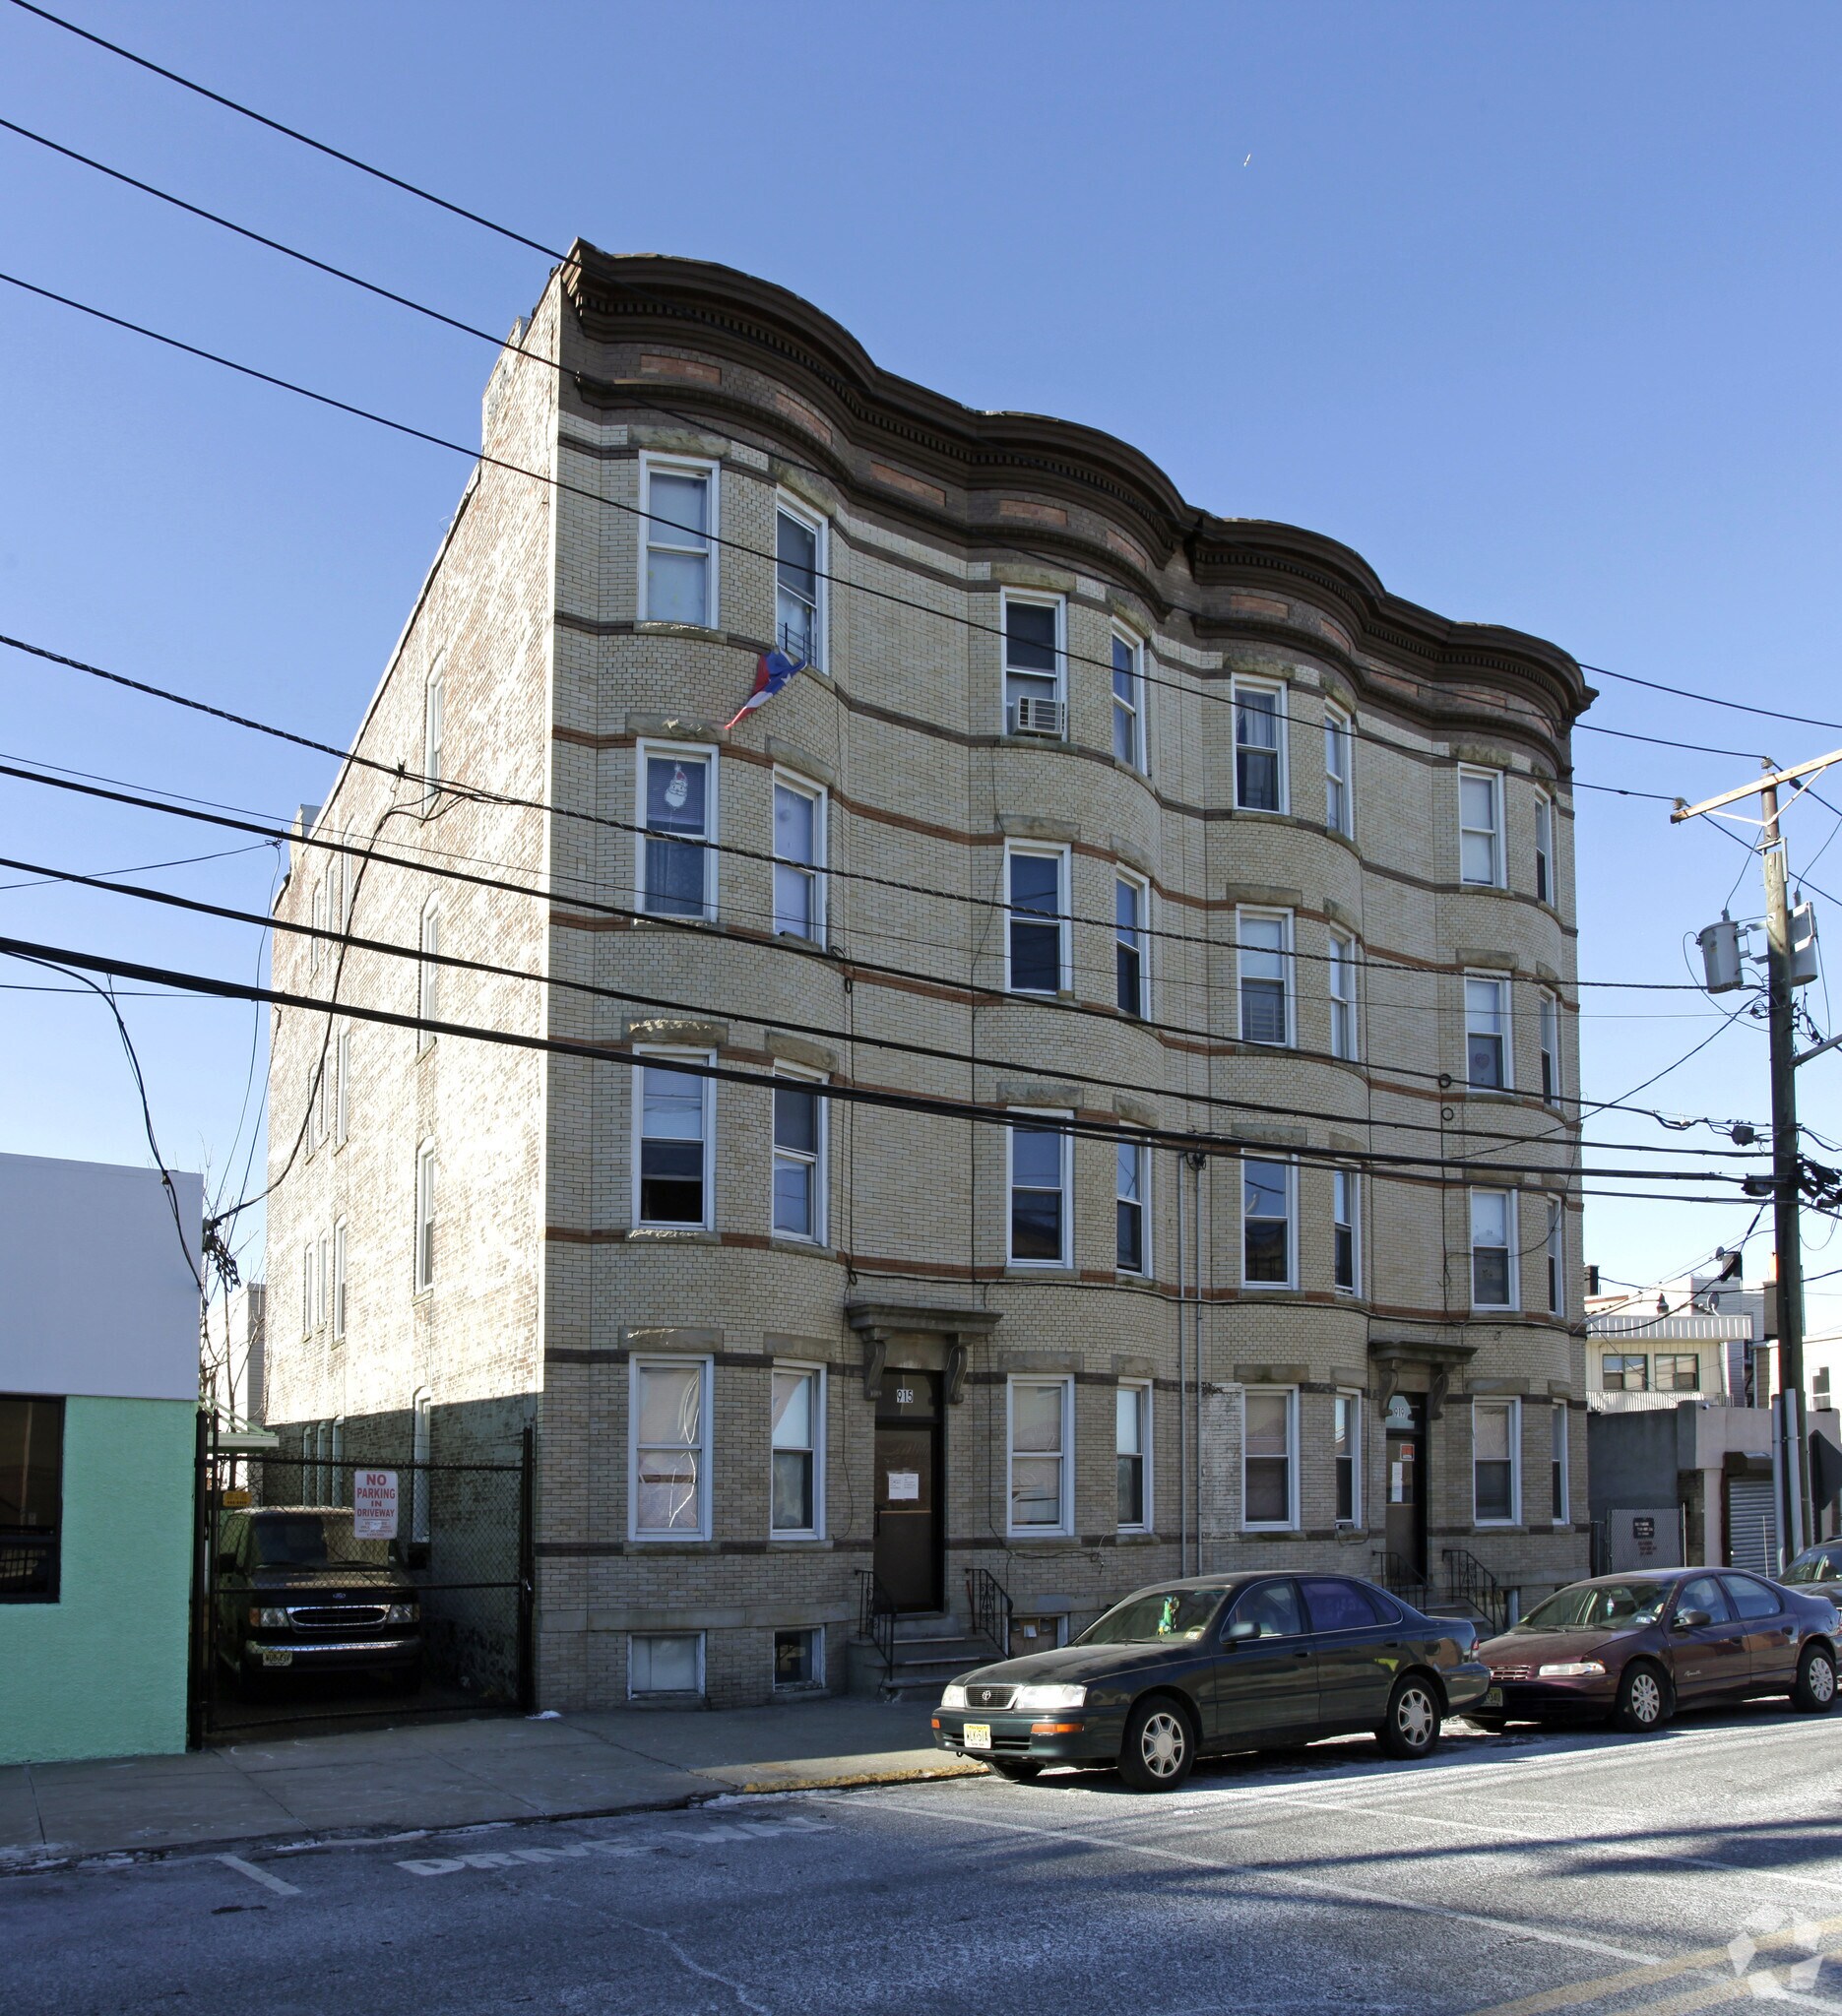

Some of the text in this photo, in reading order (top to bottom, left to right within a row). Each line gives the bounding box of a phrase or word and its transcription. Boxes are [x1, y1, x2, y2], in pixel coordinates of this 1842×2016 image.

[897, 1390, 913, 1403] 915
[1394, 1408, 1405, 1418] 919
[366, 1474, 387, 1486] NO
[356, 1487, 396, 1499] PARKING
[356, 1508, 395, 1517] DRIVEWAY
